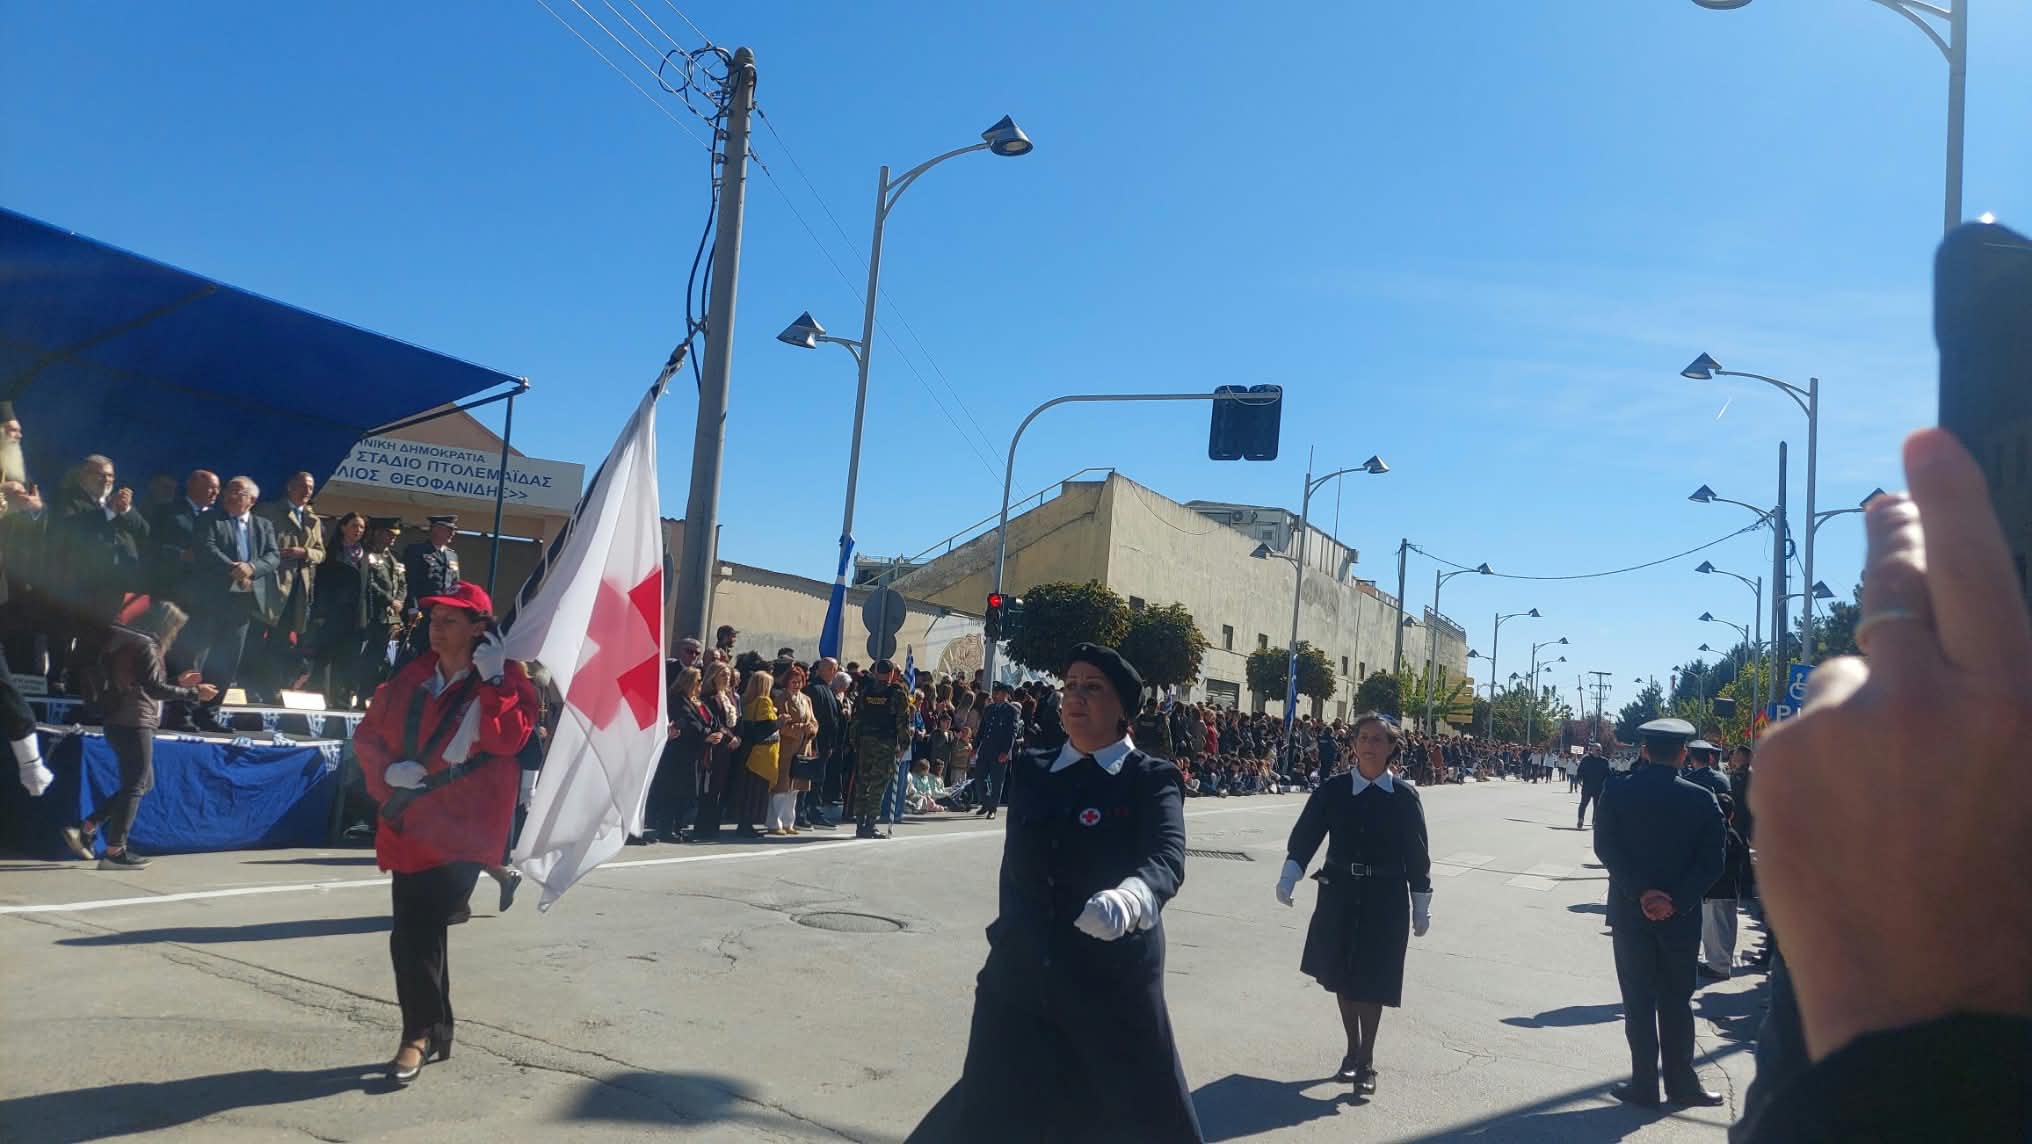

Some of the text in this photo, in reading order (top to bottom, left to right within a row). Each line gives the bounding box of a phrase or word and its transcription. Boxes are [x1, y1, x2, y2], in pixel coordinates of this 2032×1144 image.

[400, 444, 486, 463] ΔΗΜΟΚΡΑΤΙΑ
[336, 465, 380, 481] ΛΙΟΣ
[357, 450, 421, 470] ΣΤΑΔΙΟ
[427, 462, 552, 488] ΠΤΟΛΕΜΑΪΔΑΣ
